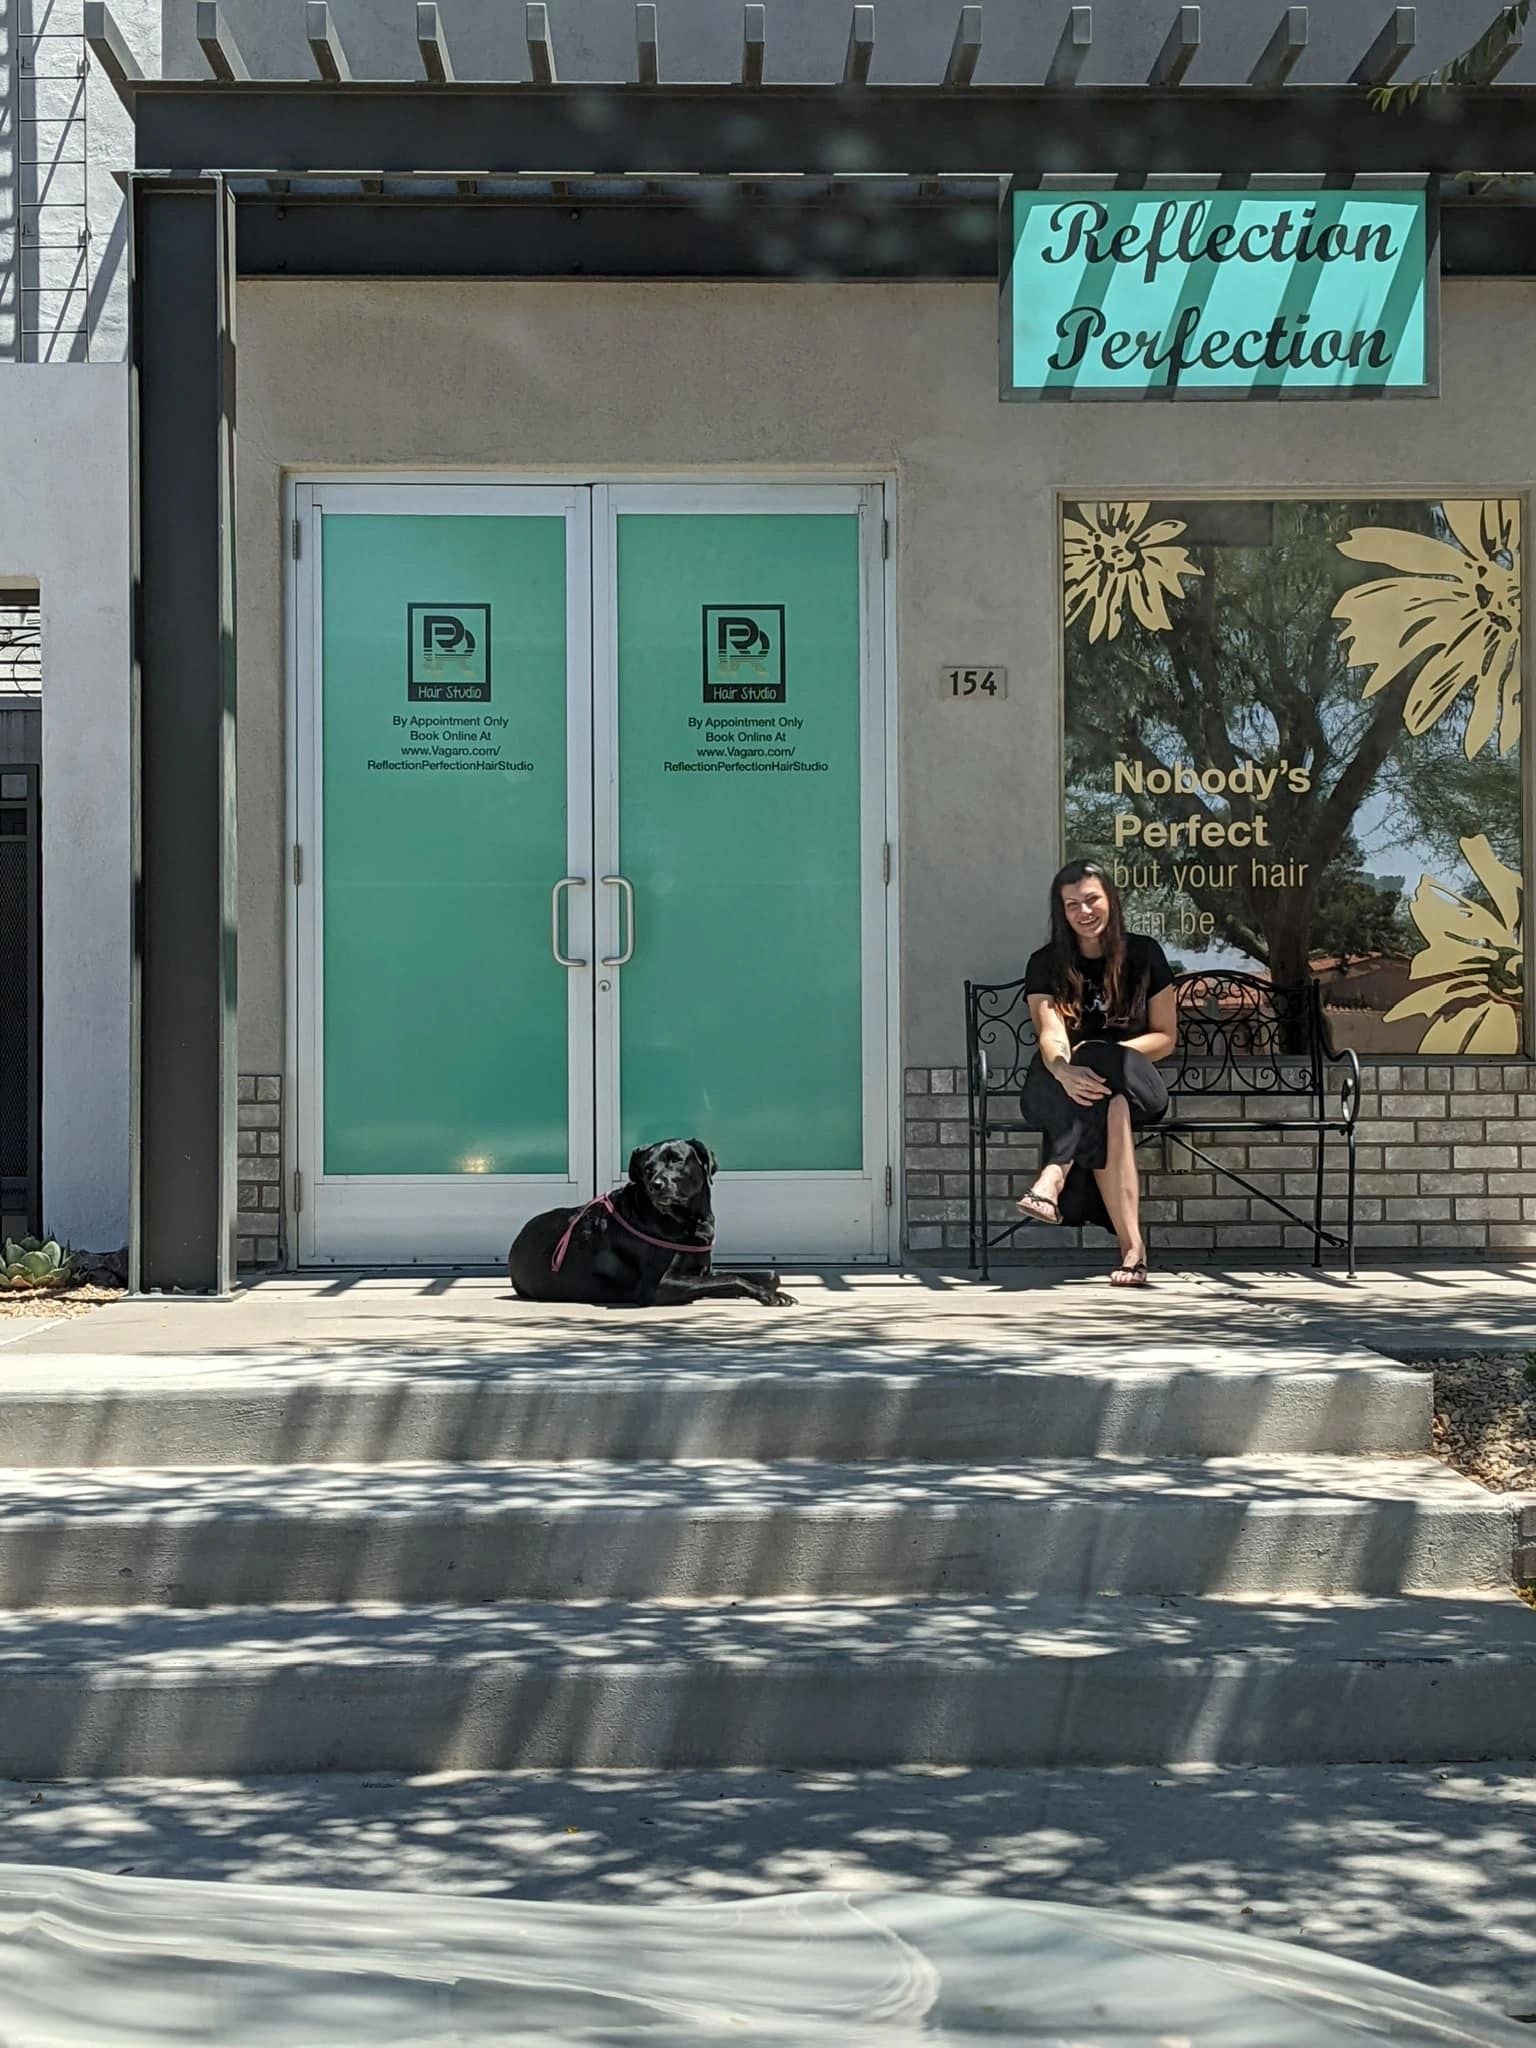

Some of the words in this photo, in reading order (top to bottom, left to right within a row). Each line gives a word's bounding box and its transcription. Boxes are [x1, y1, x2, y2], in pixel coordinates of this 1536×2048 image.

[1041, 199, 1399, 284] Reflection
[1047, 305, 1392, 386] Perfection
[949, 671, 997, 696] 154
[418, 685, 442, 699] Hair
[446, 685, 482, 699] Studio
[713, 687, 738, 700] Hair
[740, 687, 777, 700] Studio
[392, 715, 408, 728] By
[410, 716, 481, 728] Appointment
[483, 716, 509, 729] Only
[688, 717, 703, 729] By
[705, 717, 776, 729] Appointment
[778, 717, 804, 729] Only
[410, 731, 440, 742] Book
[442, 731, 478, 742] Online
[479, 731, 492, 742] At
[705, 732, 735, 743] Book
[737, 732, 773, 743] Online
[774, 732, 787, 743] At
[400, 745, 501, 758] www.Vagaro.com/
[696, 747, 796, 759] www.Vagaro.com/
[367, 760, 535, 772] ReflectionPerfectionHairStudio
[663, 761, 829, 773] ReflectionPerfectionHairStudio
[1114, 760, 1311, 800] Nobody's
[1114, 814, 1270, 848] Perfect
[1113, 858, 1161, 888] but
[1173, 863, 1238, 892] your
[1251, 857, 1309, 888] hair
[1121, 911, 1166, 936] an
[1180, 905, 1216, 935] be
